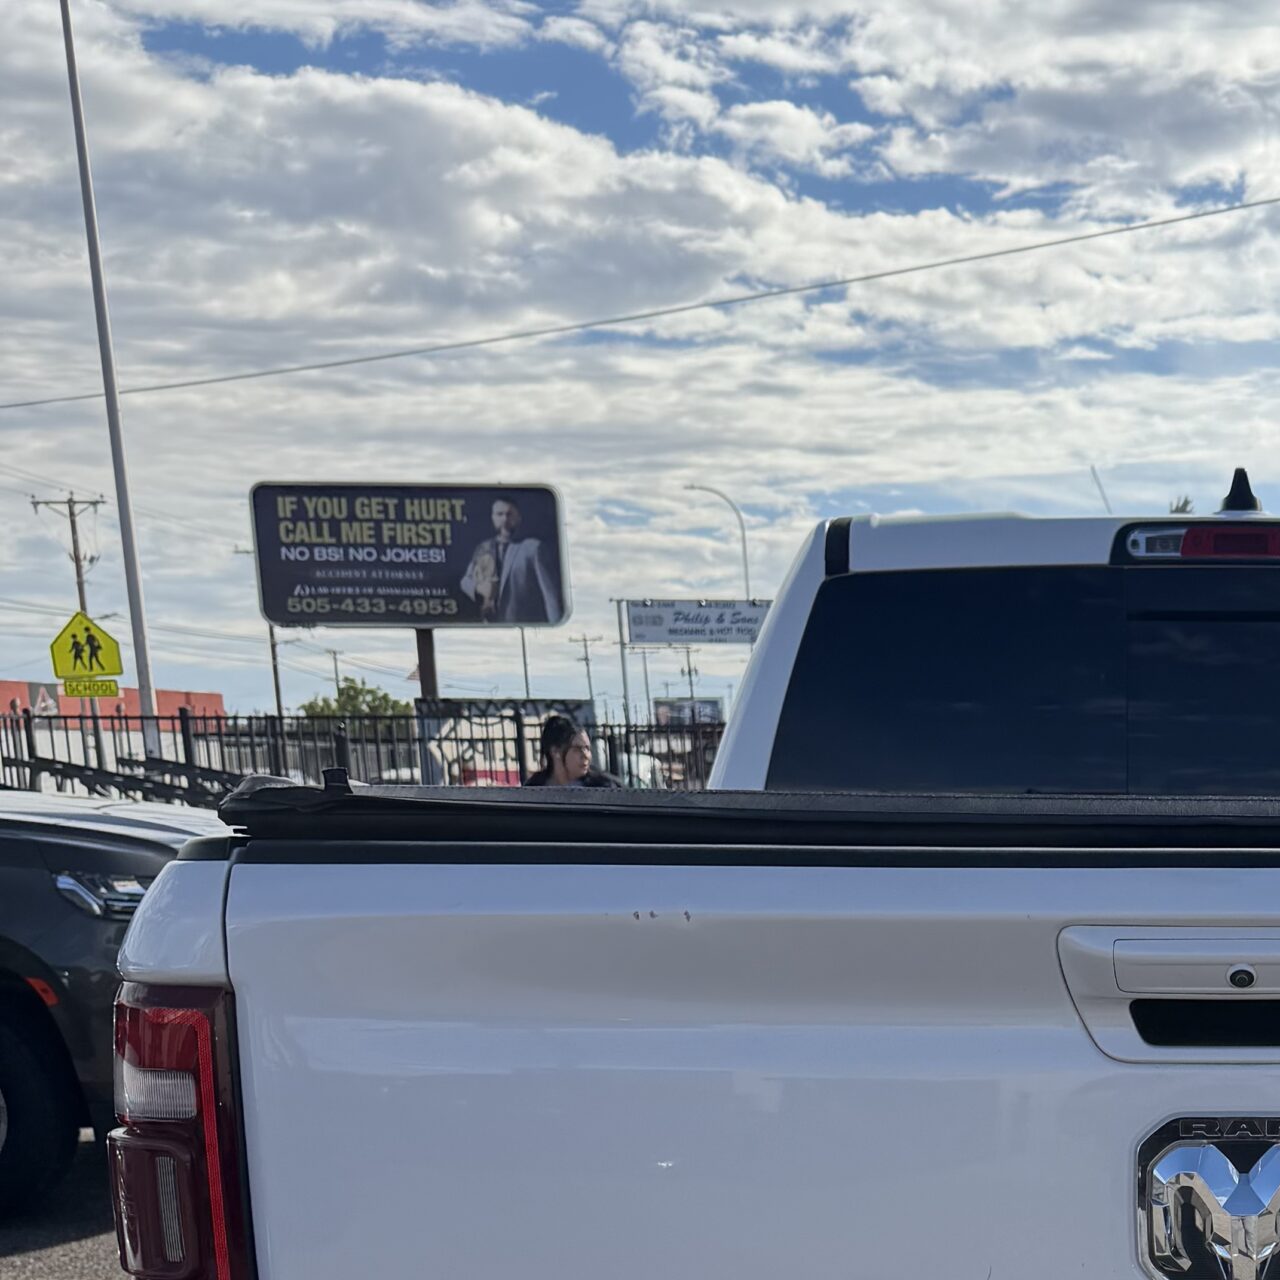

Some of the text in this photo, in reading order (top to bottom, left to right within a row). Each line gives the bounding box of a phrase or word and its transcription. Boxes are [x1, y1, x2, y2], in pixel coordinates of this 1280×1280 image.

[277, 496, 467, 523] IF YOU GET HURT,
[279, 520, 452, 545] CALL ME FIRST!
[280, 547, 446, 563] NO BS! NO JOKES!
[287, 597, 458, 615] 505-433-4953
[673, 611, 710, 626] Philip
[730, 611, 759, 624] Sons
[67, 681, 115, 695] SCHOOL
